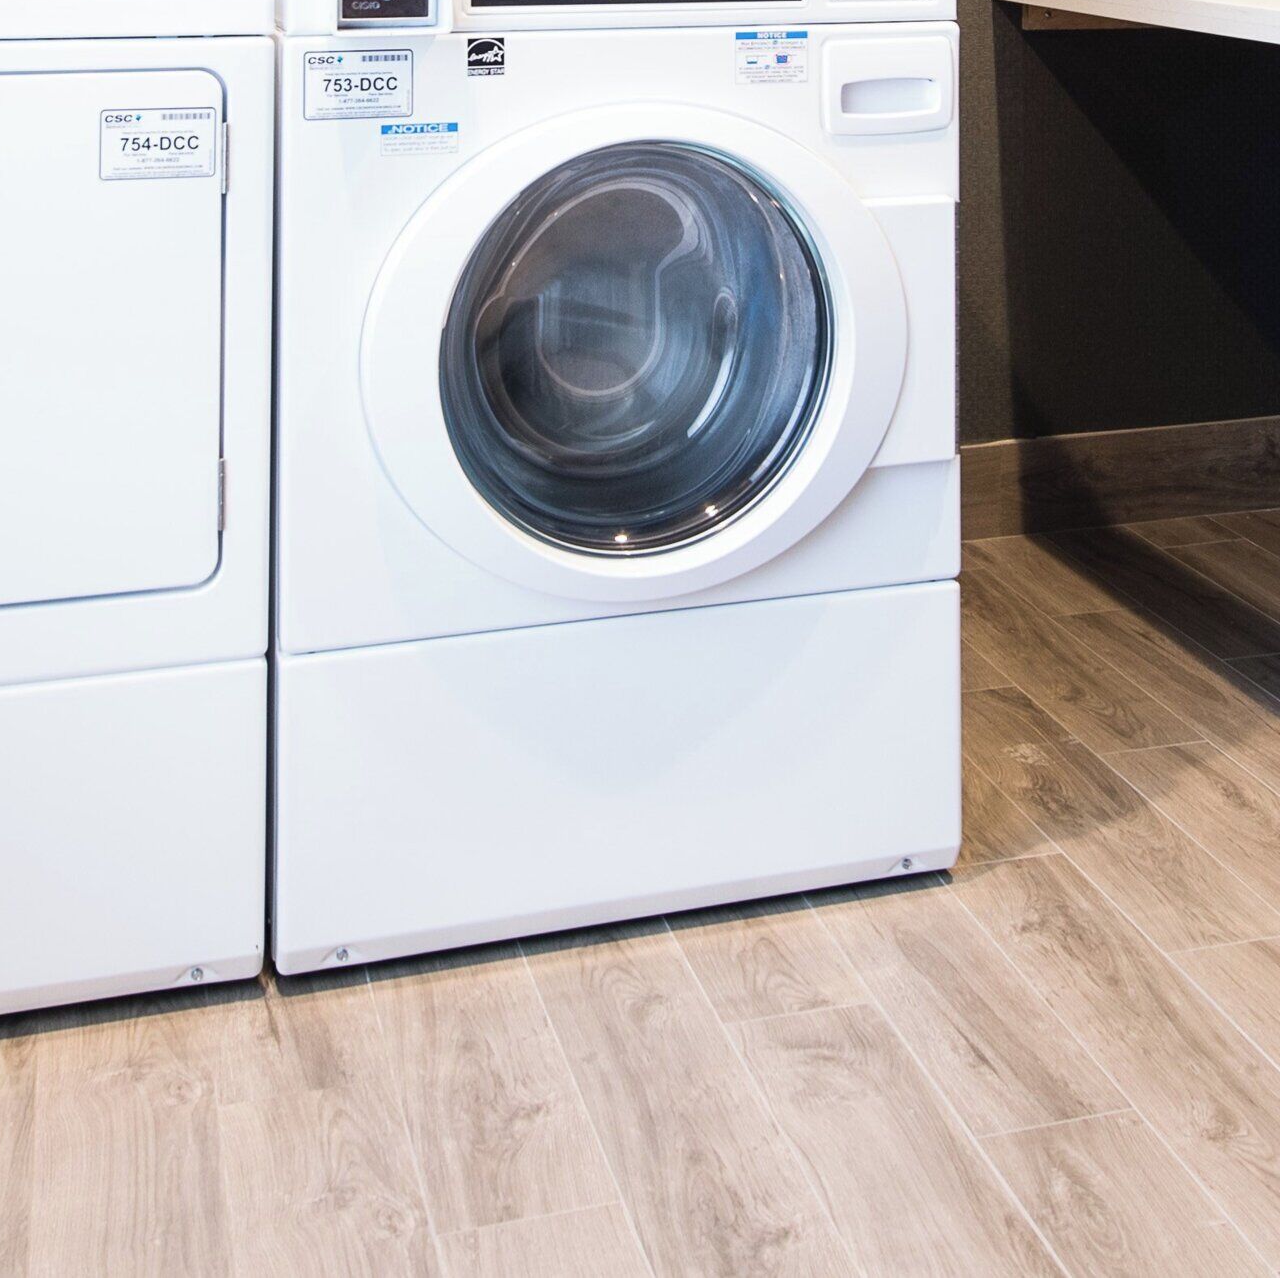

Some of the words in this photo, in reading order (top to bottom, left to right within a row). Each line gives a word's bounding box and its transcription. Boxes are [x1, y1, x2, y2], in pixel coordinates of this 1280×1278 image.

[308, 56, 335, 64] CSC
[323, 76, 397, 93] 753-DCC
[105, 114, 133, 123] CSC
[392, 123, 448, 134] NOTICE
[120, 136, 199, 152] 754-DCC
